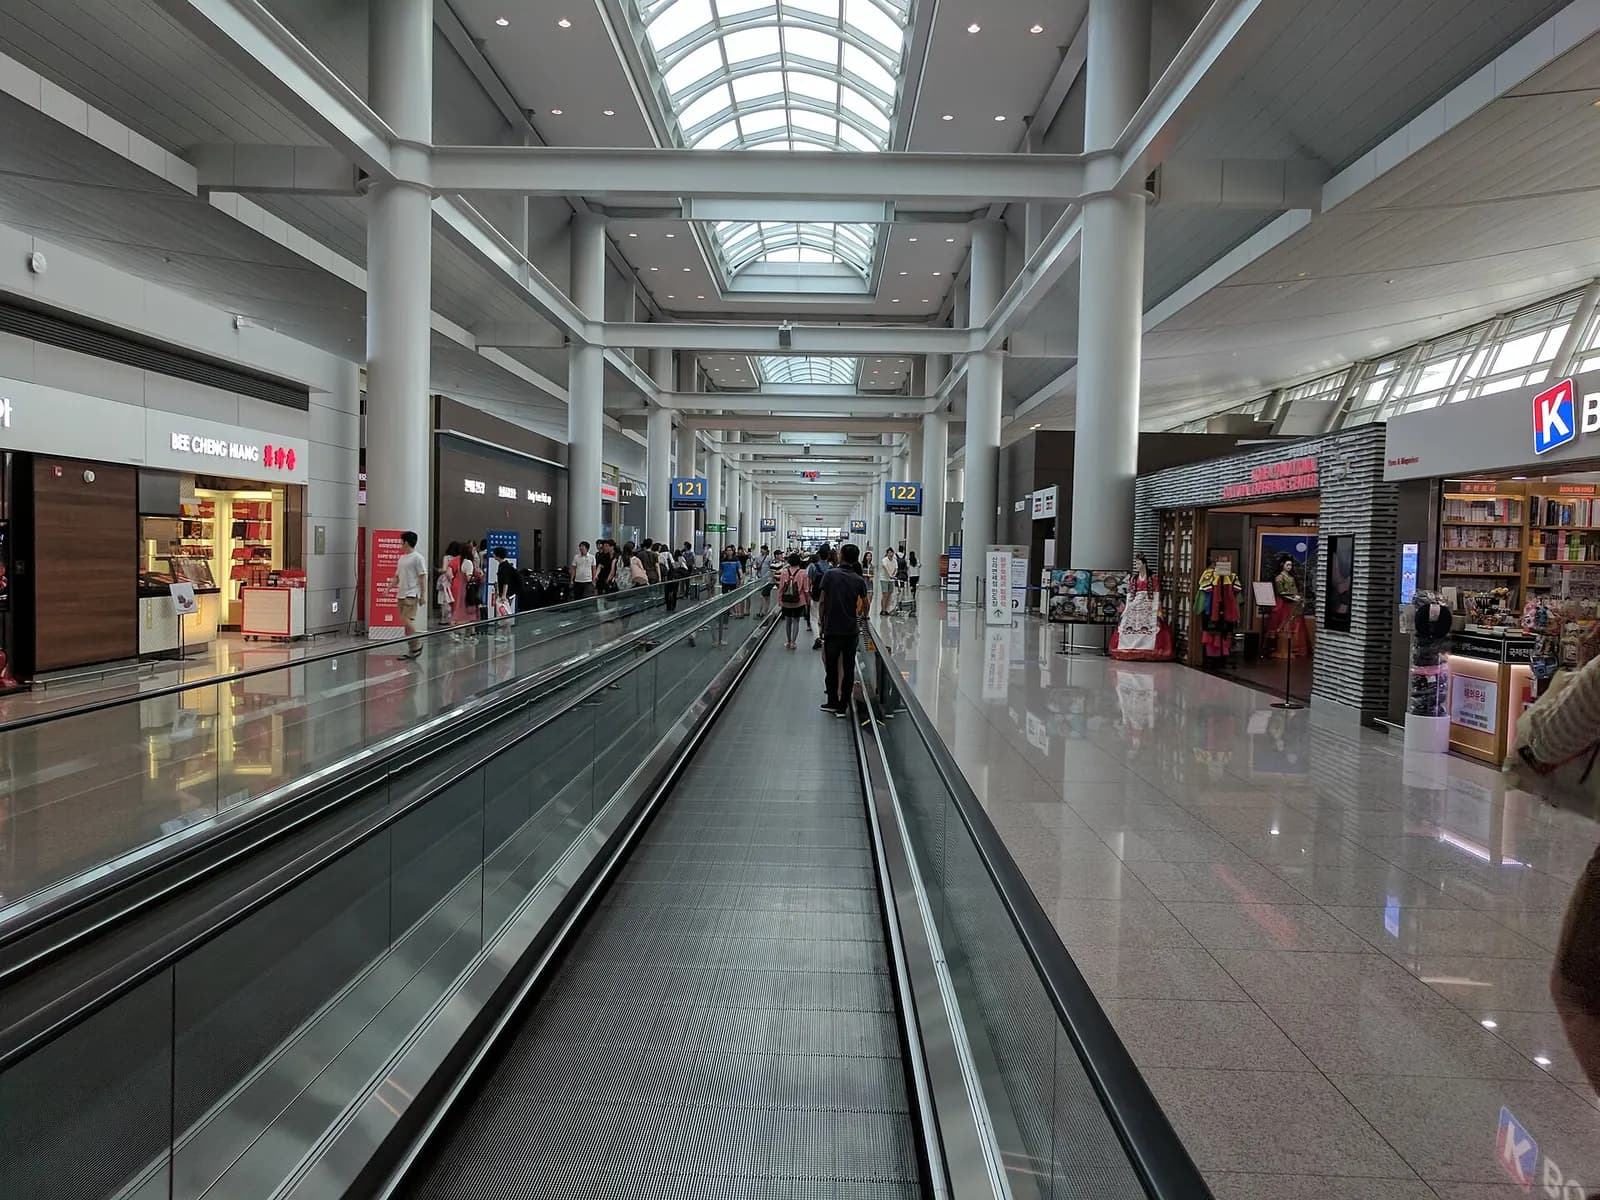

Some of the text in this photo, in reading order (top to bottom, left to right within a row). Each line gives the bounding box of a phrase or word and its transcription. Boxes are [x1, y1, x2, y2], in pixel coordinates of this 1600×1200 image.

[1541, 390, 1570, 445] K
[171, 432, 259, 462] BEE CHENG HIANG
[677, 482, 703, 496] 121
[890, 486, 916, 500] 122
